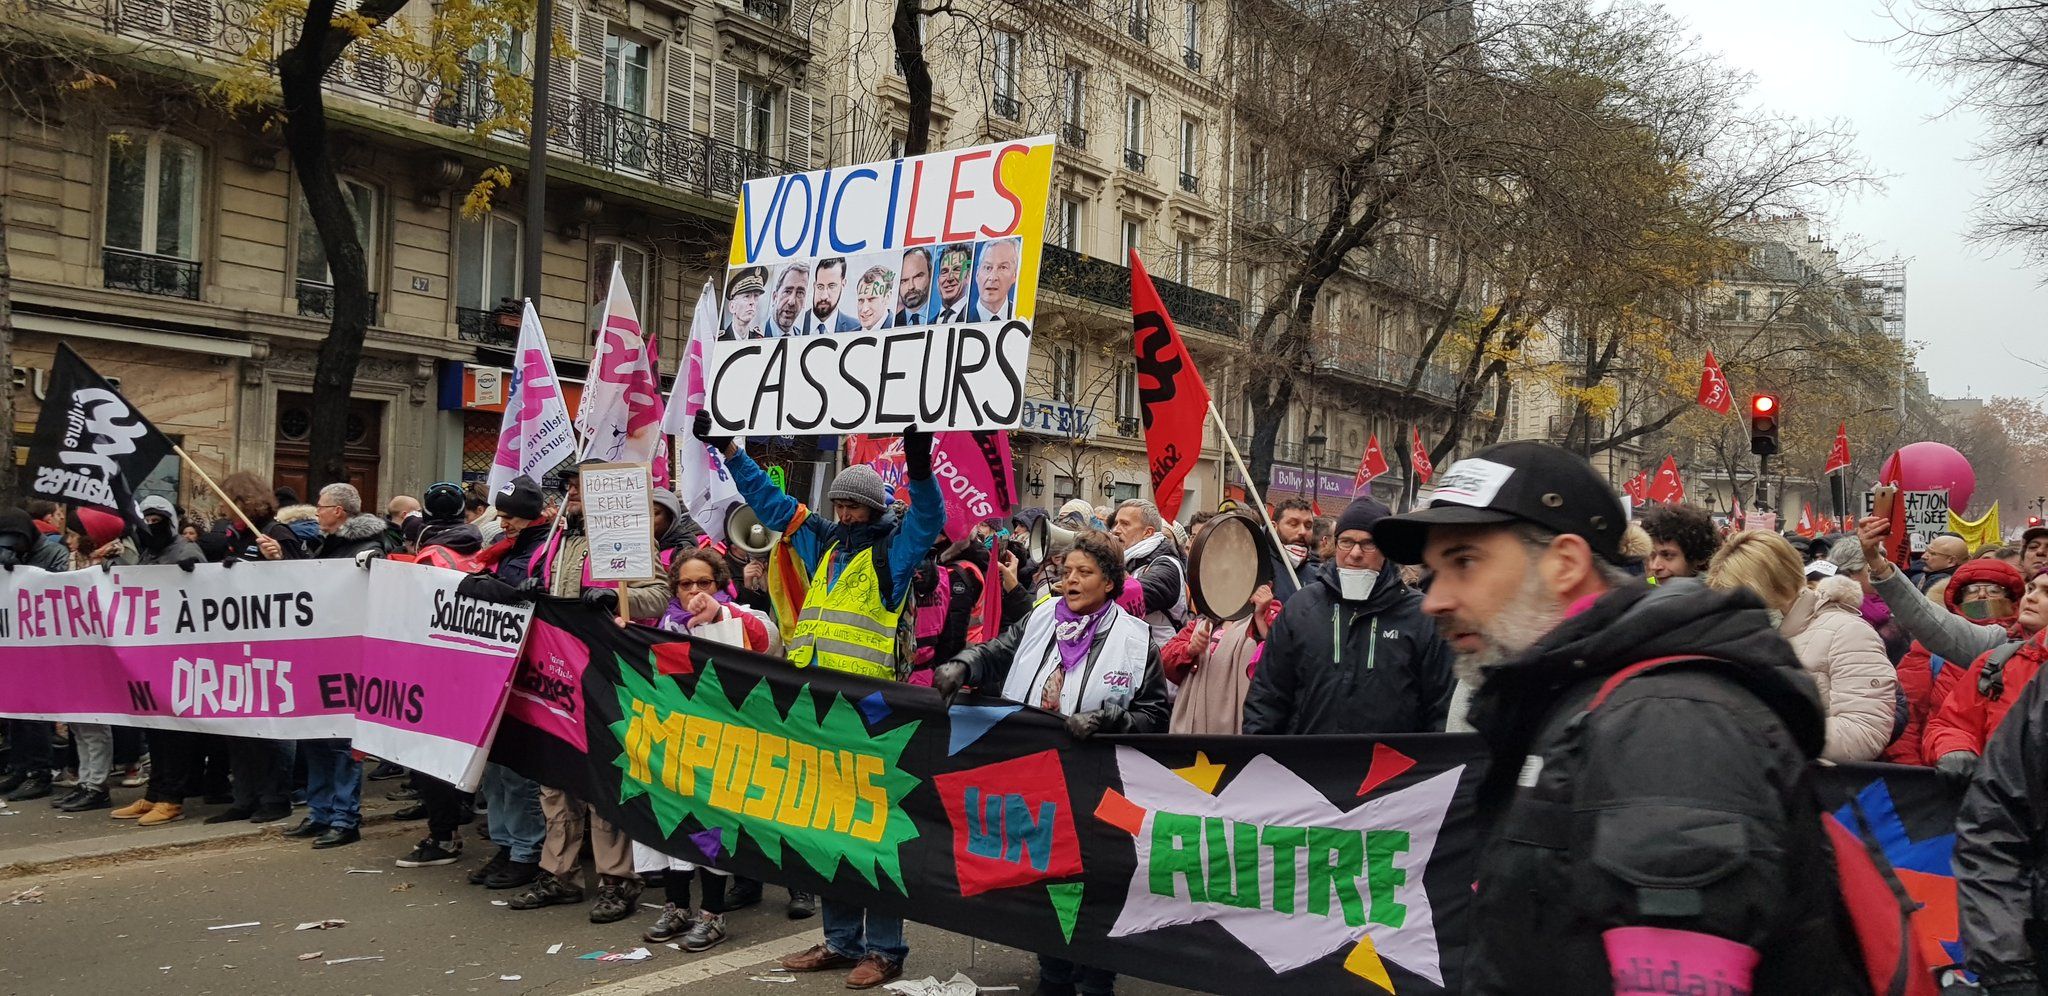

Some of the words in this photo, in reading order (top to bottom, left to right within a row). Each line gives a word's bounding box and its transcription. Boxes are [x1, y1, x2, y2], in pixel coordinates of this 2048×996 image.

[743, 158, 905, 264] VOICI
[903, 144, 1031, 248] LES
[414, 278, 428, 290] 47
[711, 320, 1031, 431] CASSEURS
[1021, 401, 1089, 434] OTEL
[586, 475, 645, 492] HÔPITAL
[598, 494, 633, 510] RENÉ
[1320, 476, 1340, 491] Plaza
[594, 514, 643, 529] MURET
[175, 589, 196, 633] À
[203, 591, 314, 632] POINTS
[431, 589, 525, 644] Solidaires
[127, 680, 158, 711] NI
[357, 676, 424, 724] OINS
[963, 786, 1057, 873] UN
[1148, 810, 1411, 929] AUTRE
